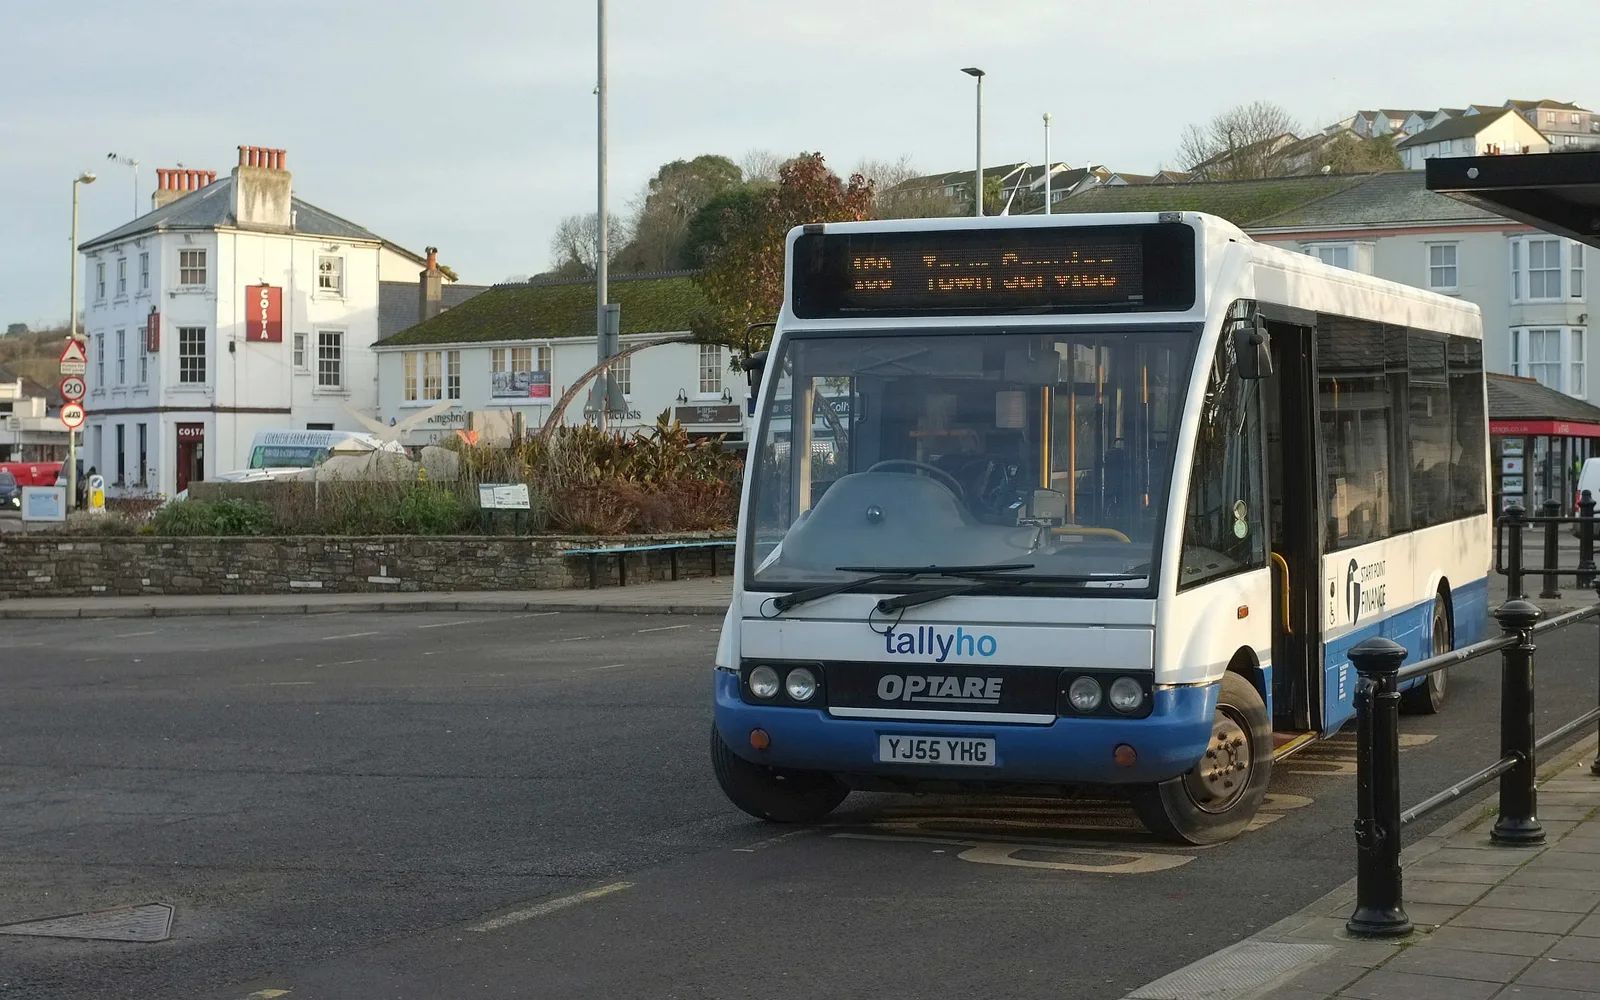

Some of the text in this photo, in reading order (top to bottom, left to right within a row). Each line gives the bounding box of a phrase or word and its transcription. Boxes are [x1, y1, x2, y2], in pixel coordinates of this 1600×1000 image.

[923, 255, 992, 291] Town
[260, 289, 269, 339] COSTA
[64, 383, 83, 394] 20
[1361, 584, 1386, 614] FINANCE
[884, 626, 997, 662] tallyho
[877, 674, 1004, 702] OPTARE
[888, 739, 987, 761] YJ55 YHG
